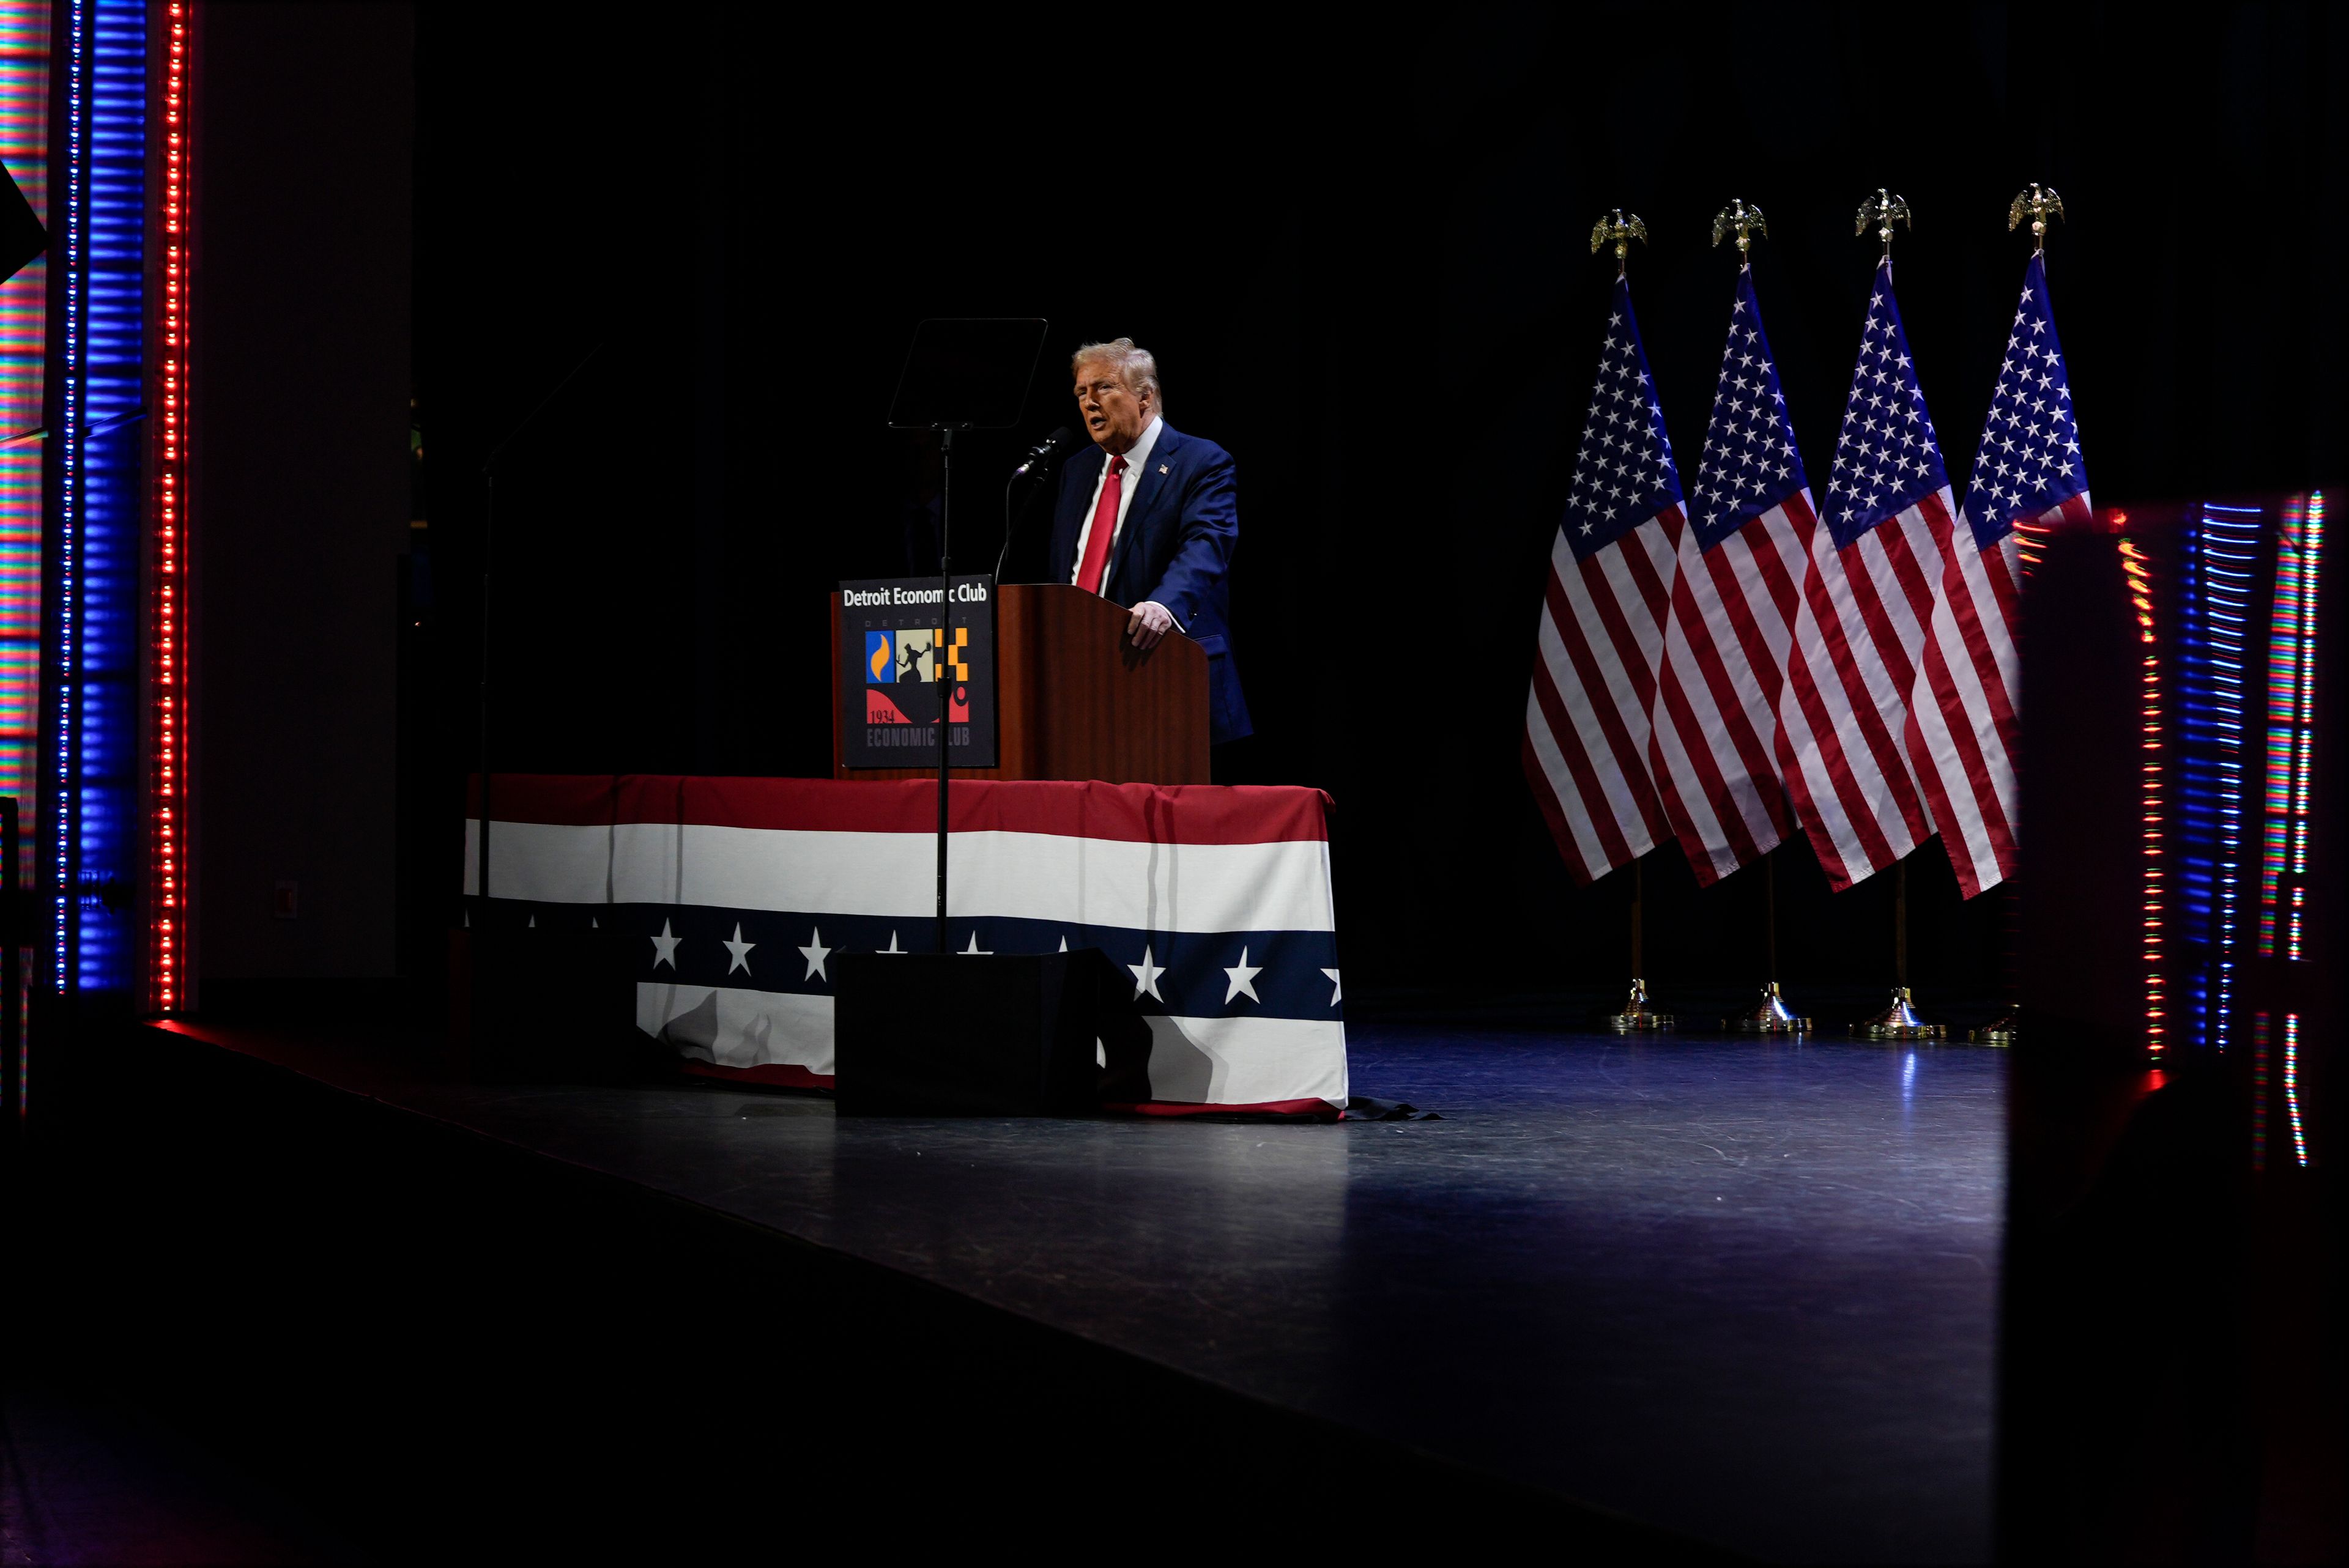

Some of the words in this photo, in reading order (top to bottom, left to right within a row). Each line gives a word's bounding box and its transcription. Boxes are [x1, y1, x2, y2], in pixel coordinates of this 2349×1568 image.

[844, 588, 891, 606] Detroit
[893, 587, 955, 605] Economc
[957, 582, 987, 602] Club
[870, 709, 895, 724] 1934
[867, 727, 935, 747] ECONOMIC
[948, 727, 970, 746] LUB
